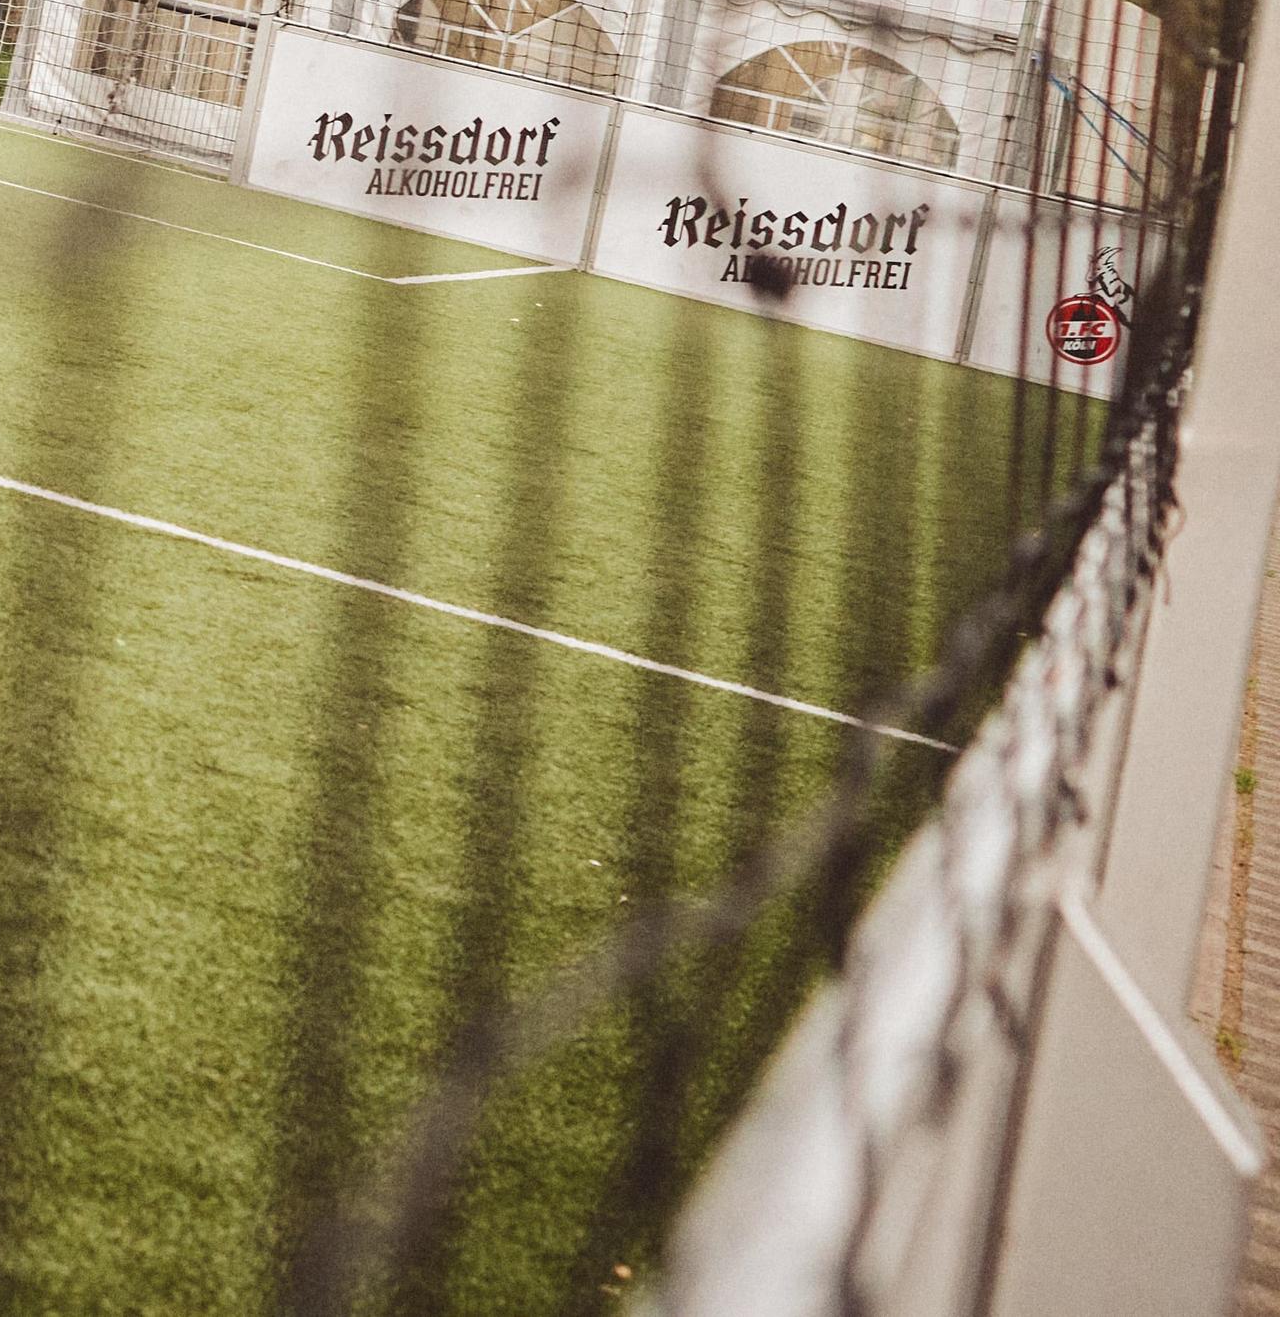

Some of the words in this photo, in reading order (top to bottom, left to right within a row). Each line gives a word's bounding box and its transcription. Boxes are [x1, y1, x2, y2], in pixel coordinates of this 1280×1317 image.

[307, 112, 561, 168] Reissdorf
[365, 168, 543, 201] ALKOHOLFREI
[657, 192, 931, 256] Reissdorf
